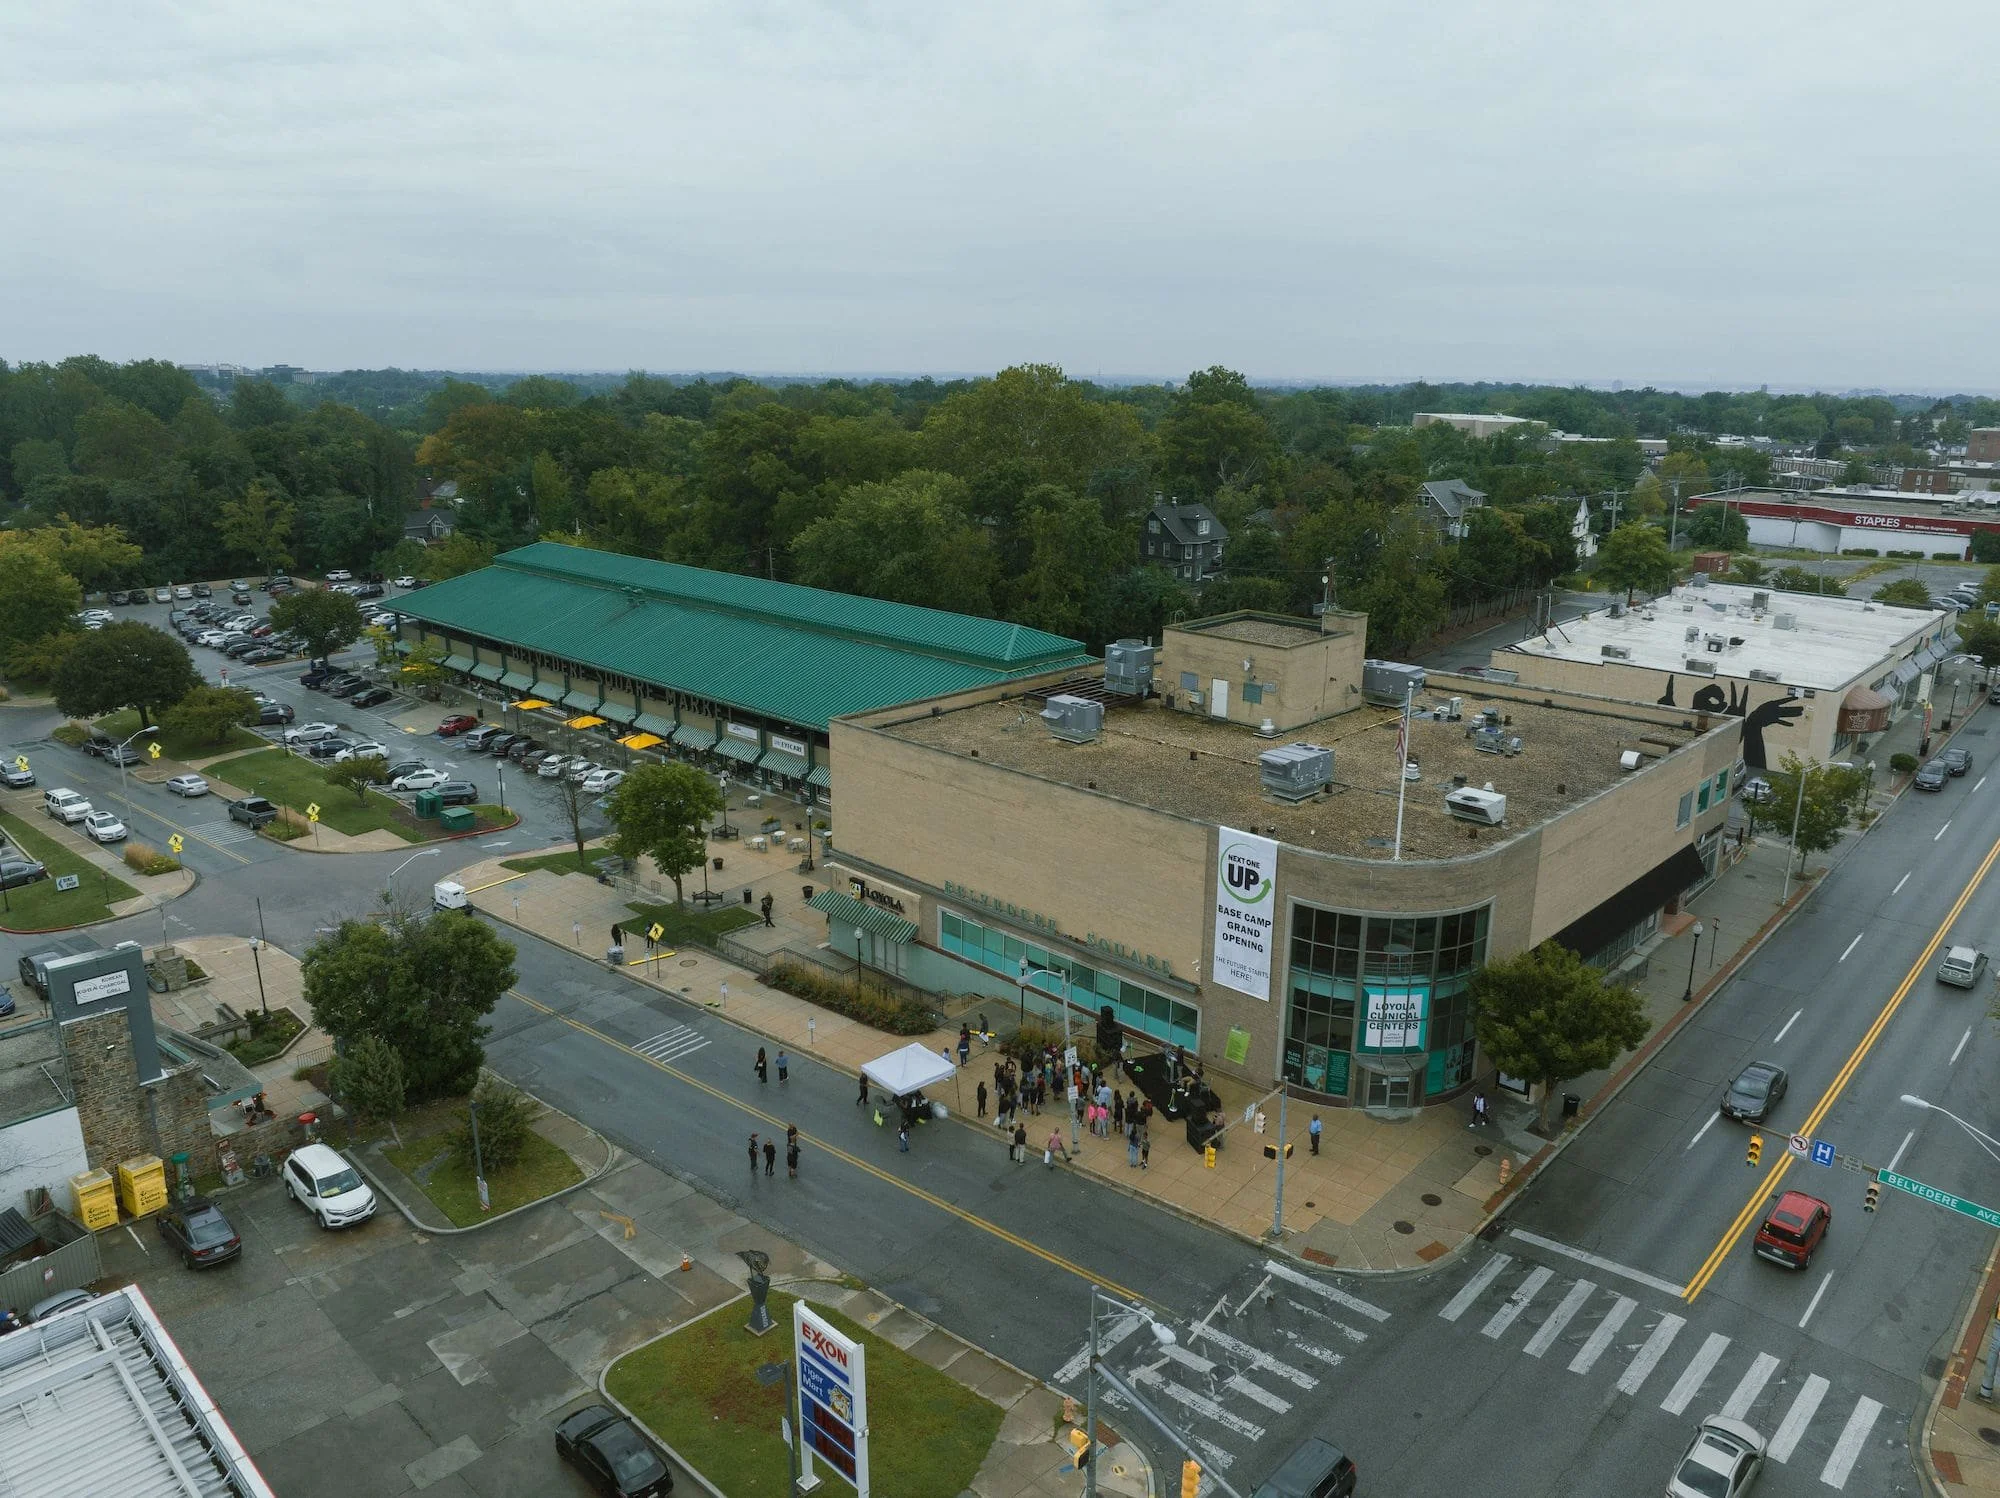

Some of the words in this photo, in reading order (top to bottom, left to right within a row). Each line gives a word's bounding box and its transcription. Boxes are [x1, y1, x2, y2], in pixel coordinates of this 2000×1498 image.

[1854, 515, 1900, 528] STAPLES
[1228, 854, 1245, 865] NEXT
[1246, 859, 1260, 870] ONE
[1227, 863, 1260, 891] UP
[866, 887, 906, 914] LOYOLA
[1218, 904, 1242, 919] BASE
[1244, 913, 1272, 928] CAMP
[1227, 921, 1260, 938] GRAND
[1222, 932, 1264, 953] OPENING
[1215, 955, 1225, 965] THE
[1226, 959, 1248, 972] FUTURE
[1248, 965, 1269, 979] STARTS
[1370, 1011, 1419, 1020] CLINICAL
[1375, 1002, 1416, 1011] LOYOLA
[1369, 1022, 1418, 1030] CENTERS
[1817, 1143, 1832, 1160] H
[1888, 1174, 1960, 1208] BELVEDERE
[802, 1321, 848, 1368] EXXON
[802, 1361, 824, 1384] Tiger
[802, 1373, 824, 1397] Mart
